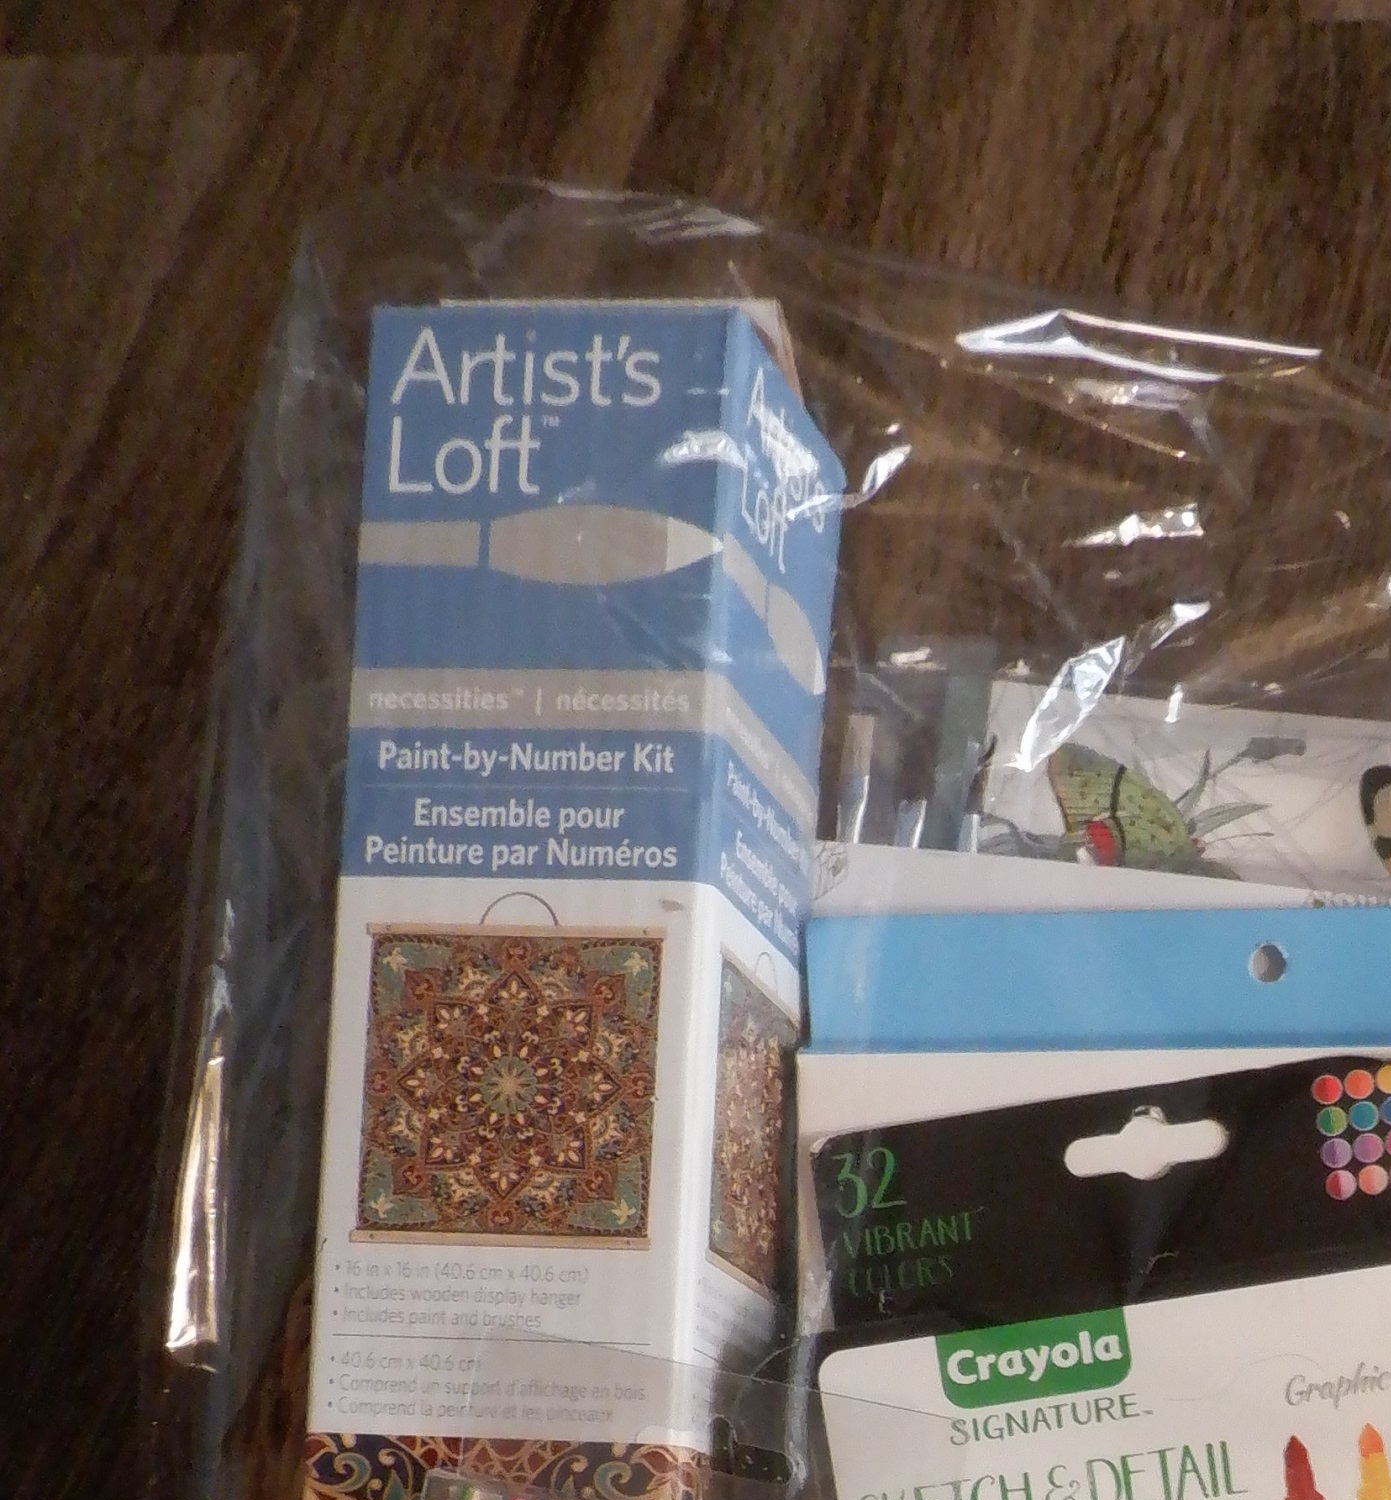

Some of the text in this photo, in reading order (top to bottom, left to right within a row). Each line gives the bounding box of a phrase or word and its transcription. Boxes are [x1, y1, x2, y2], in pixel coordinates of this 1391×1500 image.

[391, 326, 662, 407] Artist's
[378, 740, 675, 775] Paint-by-Number Kit
[413, 797, 625, 835] Ensemble pour
[365, 835, 677, 871] Peinture par Numéros
[832, 1147, 907, 1218] 32
[842, 1211, 974, 1259] VIBRANT
[345, 1260, 361, 1277] 16
[434, 1260, 475, 1281] (40.6
[479, 1266, 503, 1280] cm
[520, 1263, 554, 1282] 40.6
[558, 1265, 590, 1284] cm)
[344, 1283, 581, 1309] Includes wooden display hanger
[342, 1306, 541, 1329] Includes paint and brushes
[340, 1351, 376, 1369] 40.6
[379, 1356, 403, 1369] cm
[419, 1352, 454, 1371] 40.6
[946, 1330, 1124, 1385] Crayola
[339, 1373, 417, 1396] Comprend
[591, 1384, 610, 1400] en
[614, 1383, 646, 1401] bois
[1285, 1361, 1391, 1409] Graphic
[337, 1396, 416, 1419] Comprend
[420, 1398, 433, 1416] la
[949, 1392, 1140, 1446] SIGNATURE
